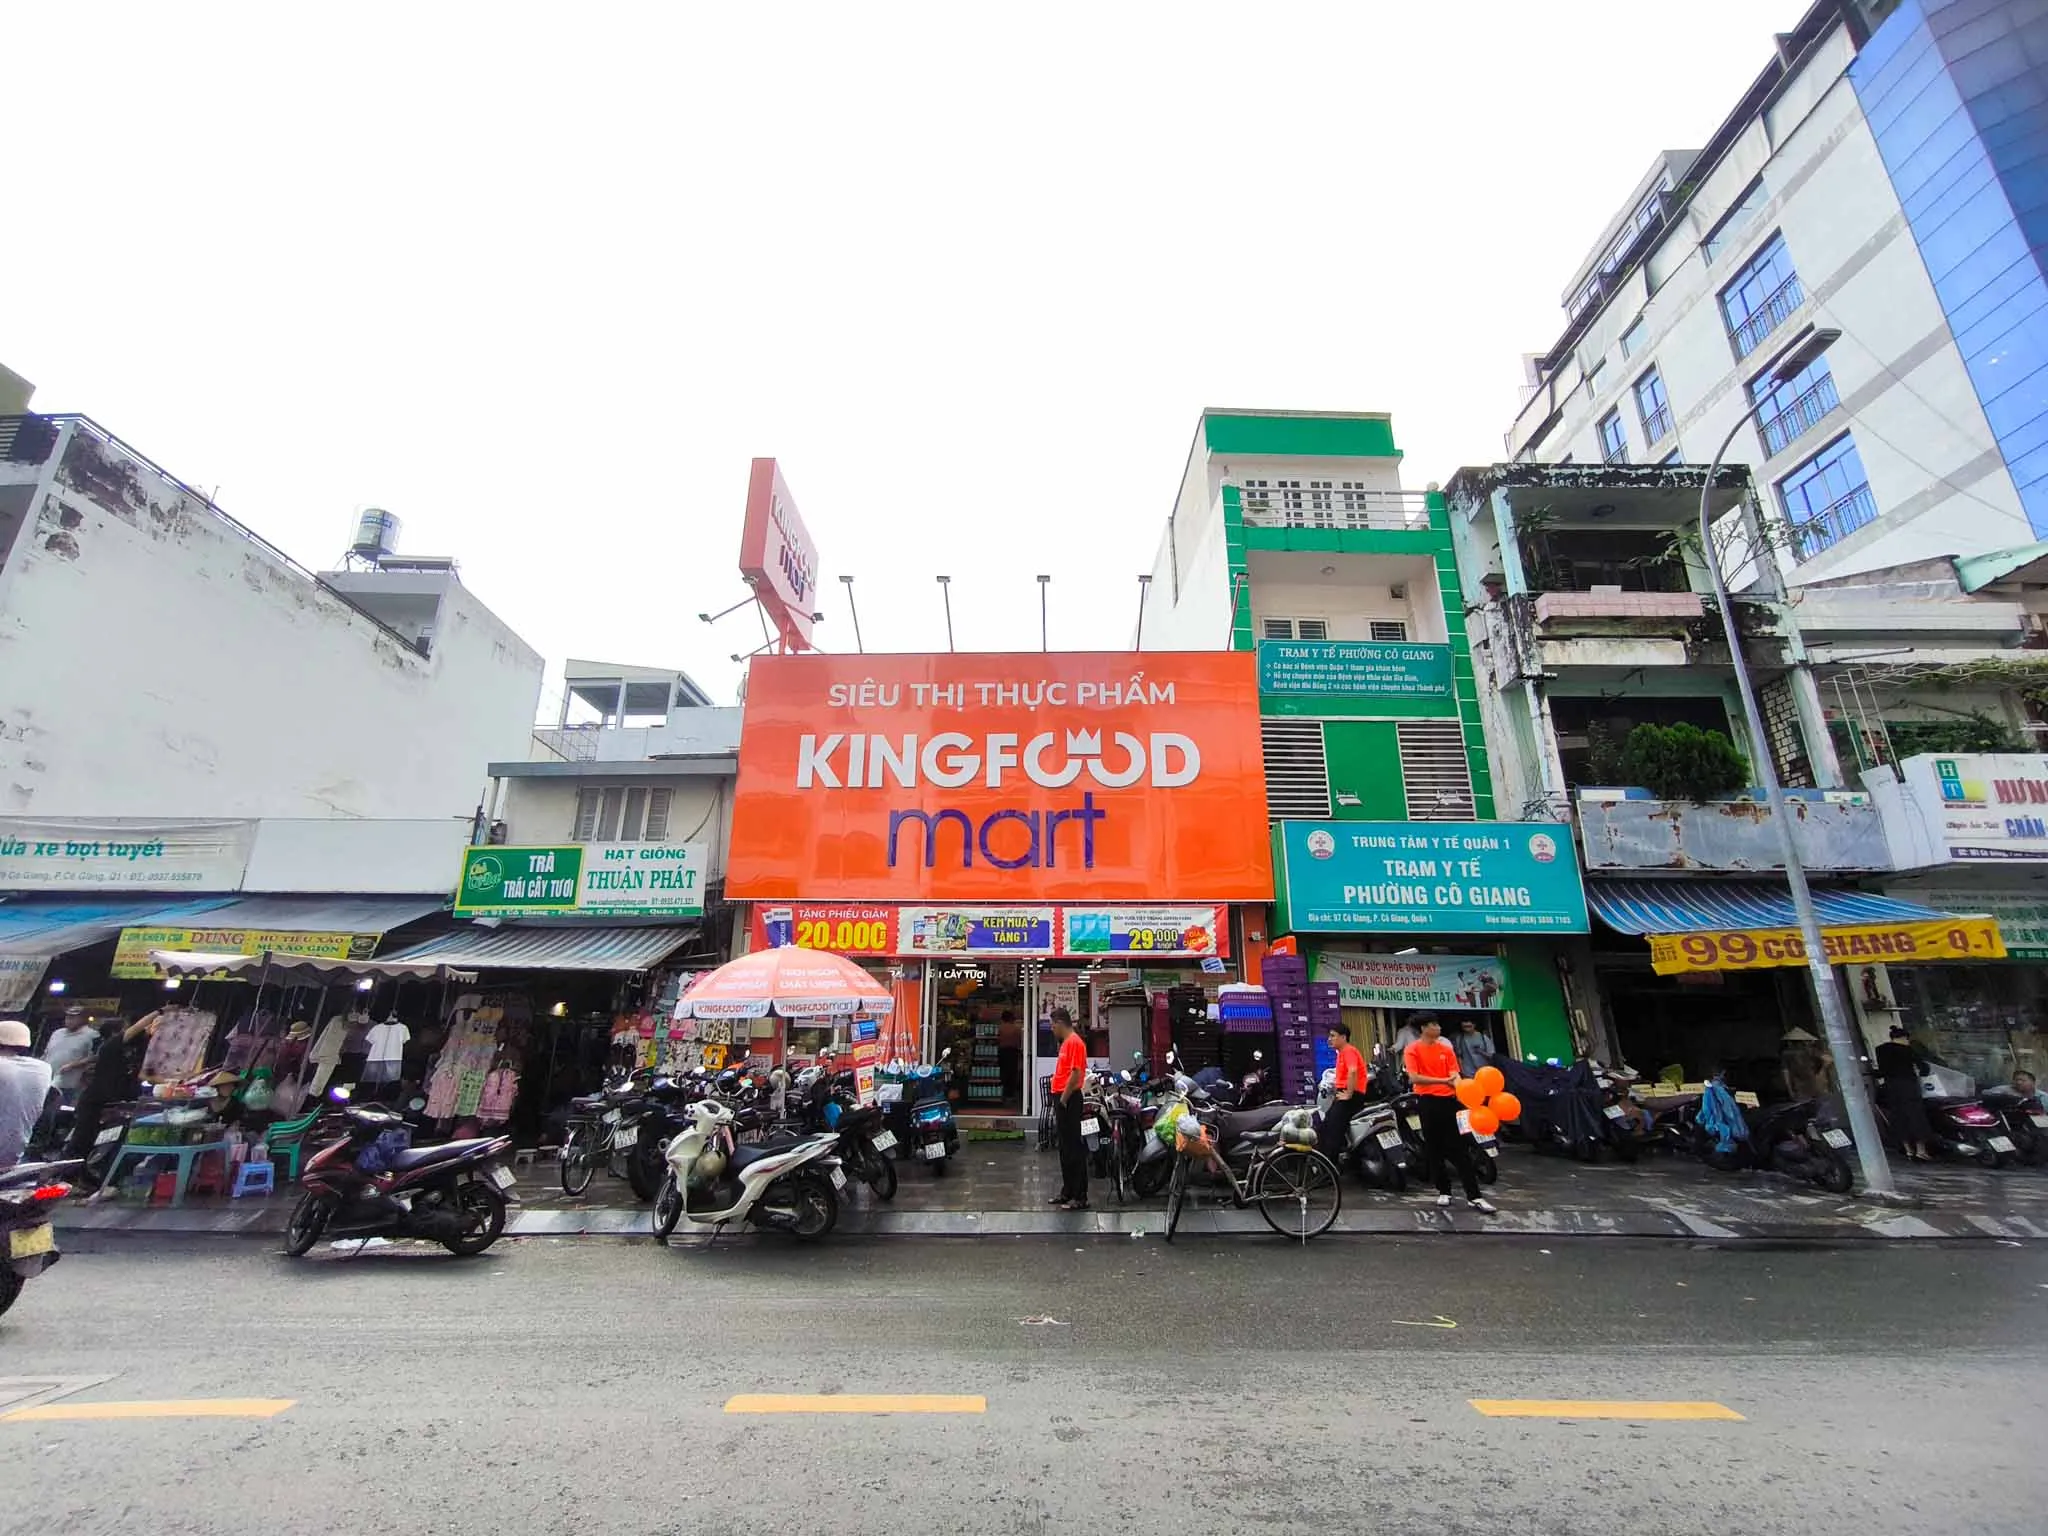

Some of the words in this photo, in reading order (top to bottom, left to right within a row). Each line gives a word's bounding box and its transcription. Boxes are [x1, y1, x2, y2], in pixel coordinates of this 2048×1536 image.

[1312, 649, 1320, 658] Y
[1322, 645, 1337, 658] TẾ
[1402, 650, 1434, 661] GIANG
[828, 677, 900, 707] SIÊU
[910, 682, 964, 712] THỊ
[974, 679, 1067, 712] THỰC
[1078, 671, 1176, 705] PHẨM
[796, 727, 1201, 789] KINGFOOD
[1941, 763, 1956, 778] H
[1946, 783, 1959, 797] T
[1993, 776, 2048, 805] HƯN
[887, 792, 1105, 869] mart
[0, 834, 27, 857] ửa
[33, 842, 58, 856] xe
[65, 840, 100, 861] bọt
[107, 837, 165, 861] tuyết
[1352, 836, 1397, 848] TRUNG
[1400, 835, 1429, 849] TÂM
[1431, 838, 1440, 849] Y
[1443, 834, 1460, 849] TẾ
[1463, 836, 1500, 851] QUẬN
[1503, 838, 1510, 849] 1
[529, 851, 555, 873] TRÀ
[604, 849, 635, 862] HẠT
[1383, 860, 1437, 879] TRẠM
[1442, 861, 1453, 877] Y
[1458, 856, 1481, 877] TẾ
[503, 876, 526, 898] TRÁI
[527, 875, 548, 898] CÂY
[550, 878, 574, 898] TƯƠI
[587, 865, 645, 894] THUẬN
[649, 865, 697, 889] PHÁT
[1343, 881, 1428, 905] PHƯỜNG
[1435, 882, 1463, 905] CÔ
[1469, 887, 1531, 906] GIANG
[983, 916, 1004, 928] KEM
[1007, 916, 1028, 928] MUA
[1031, 916, 1038, 928] 2
[797, 921, 887, 949] 20.000
[993, 930, 1021, 946] TẶNG
[1023, 931, 1028, 942] 1
[1681, 933, 1758, 968] 99
[1763, 933, 1802, 960] CÔ
[1822, 931, 1917, 959] GIANG
[1947, 929, 1994, 953] Q.1
[944, 969, 962, 979] CÂY
[963, 969, 987, 979] TƯƠI
[1394, 976, 1410, 987] CAO
